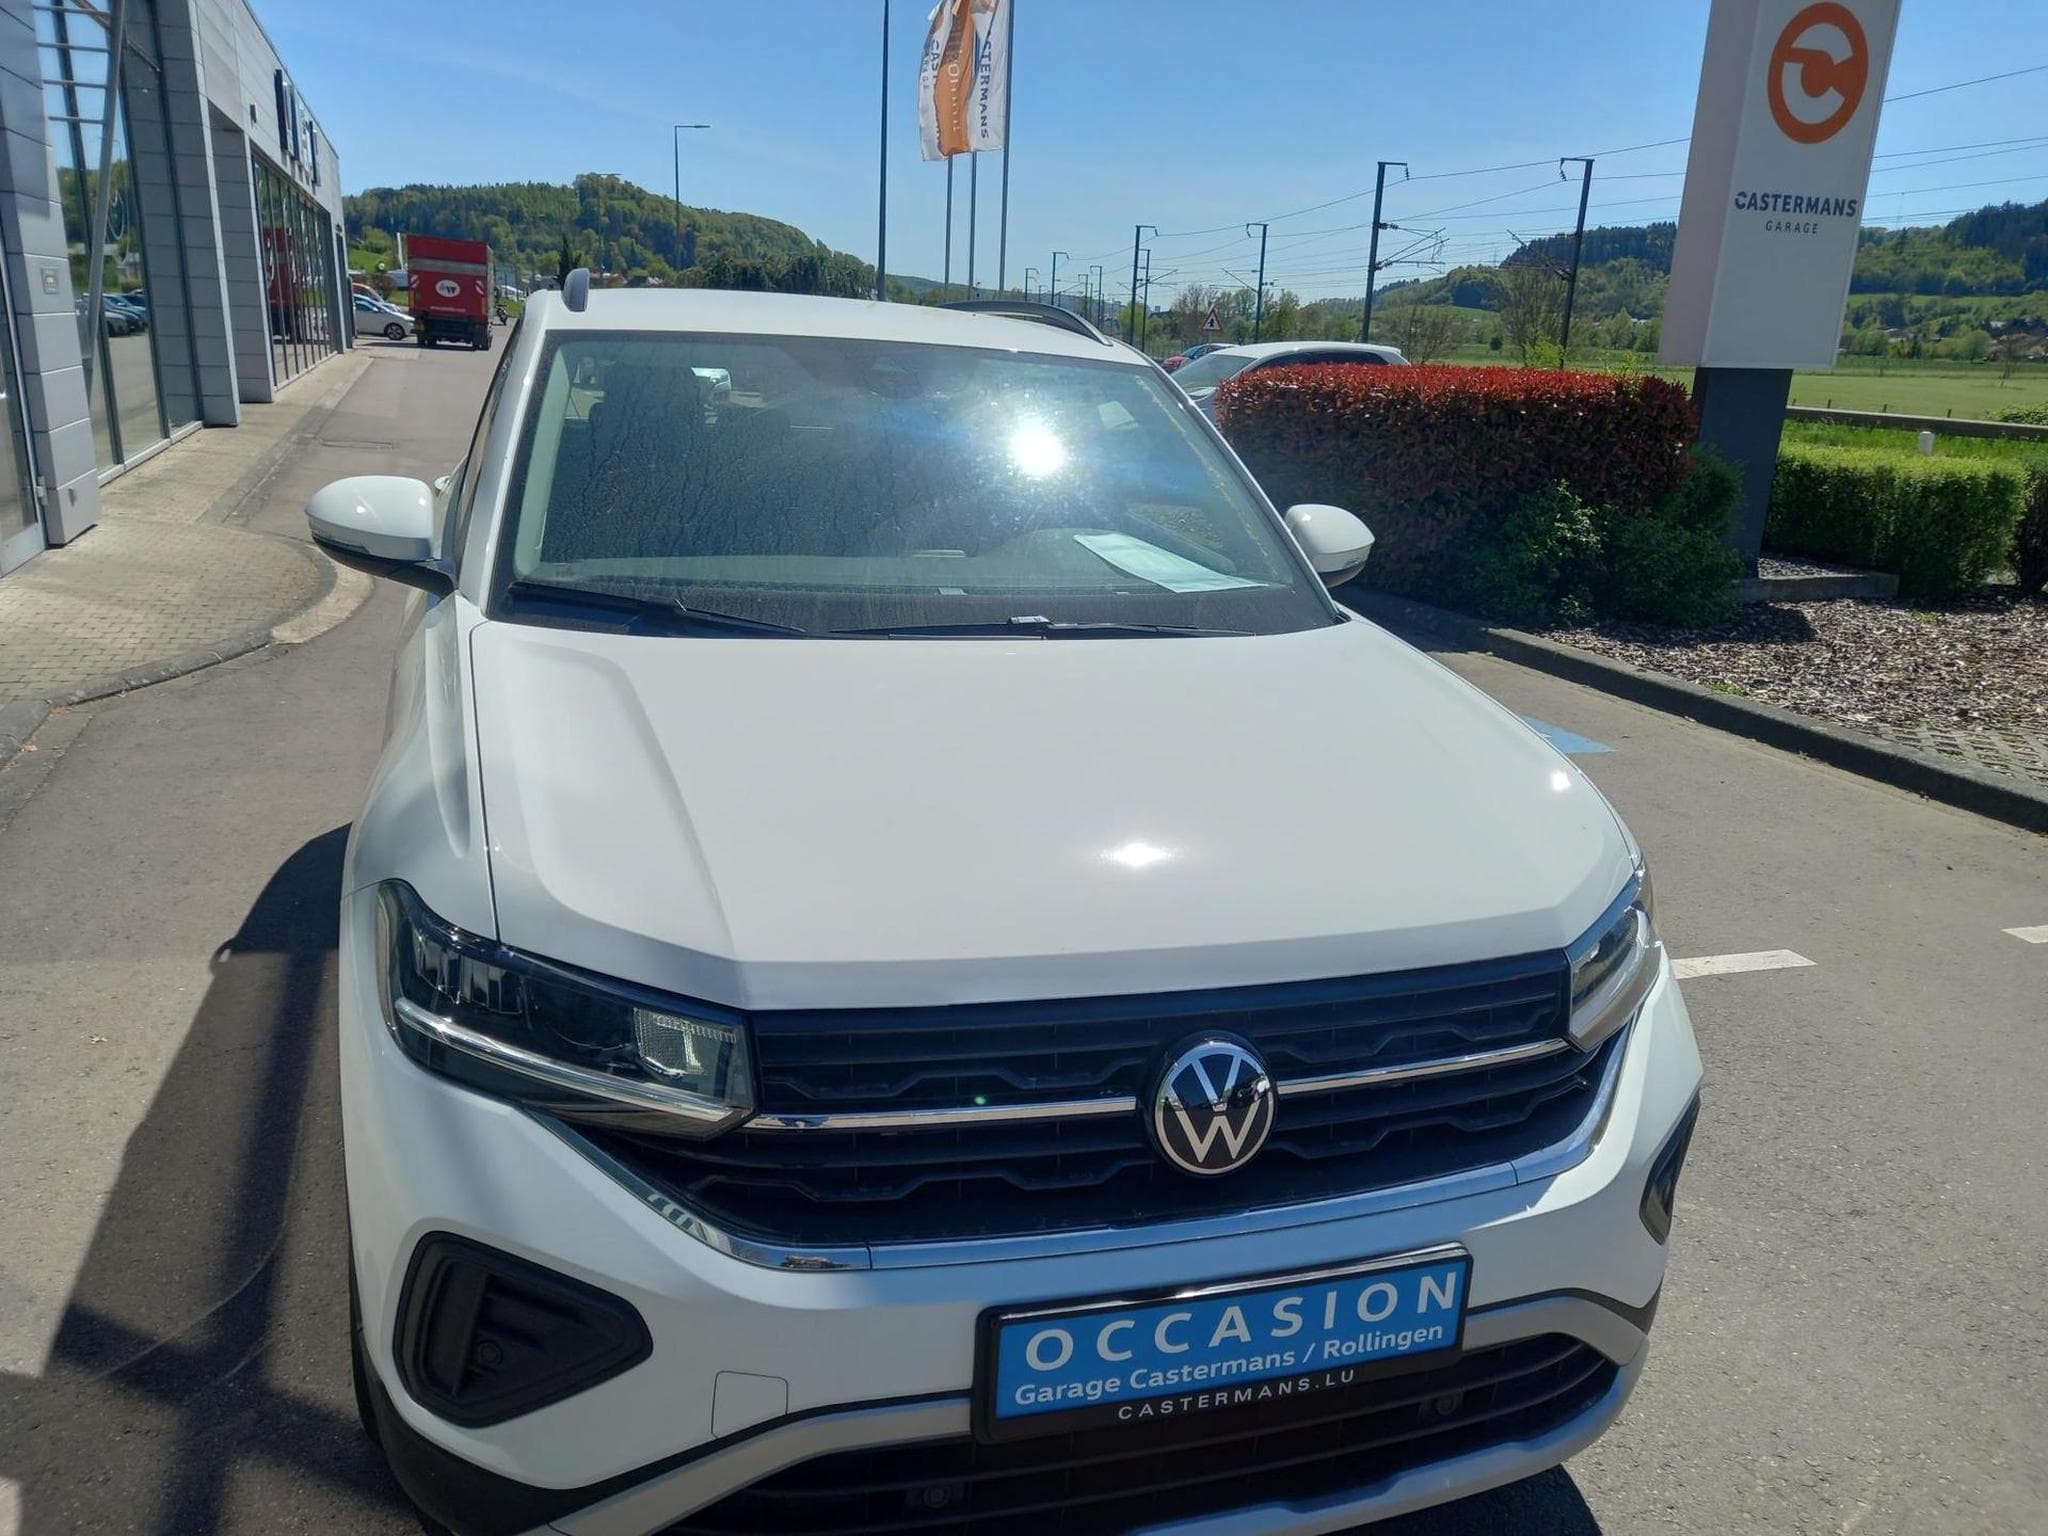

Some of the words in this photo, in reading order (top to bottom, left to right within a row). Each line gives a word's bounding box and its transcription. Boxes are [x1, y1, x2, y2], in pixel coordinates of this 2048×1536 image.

[978, 30, 992, 139] STERMANS
[1735, 191, 1858, 217] CASTERMANS
[1765, 220, 1819, 234] GARAGE
[1025, 1271, 1457, 1372] OCCASION
[1015, 1377, 1121, 1405] Garage
[1130, 1349, 1295, 1389] Castermans
[1302, 1343, 1316, 1364] /
[1323, 1324, 1444, 1360] Rollingen
[1118, 1369, 1355, 1420] CASTERMANS.LU
